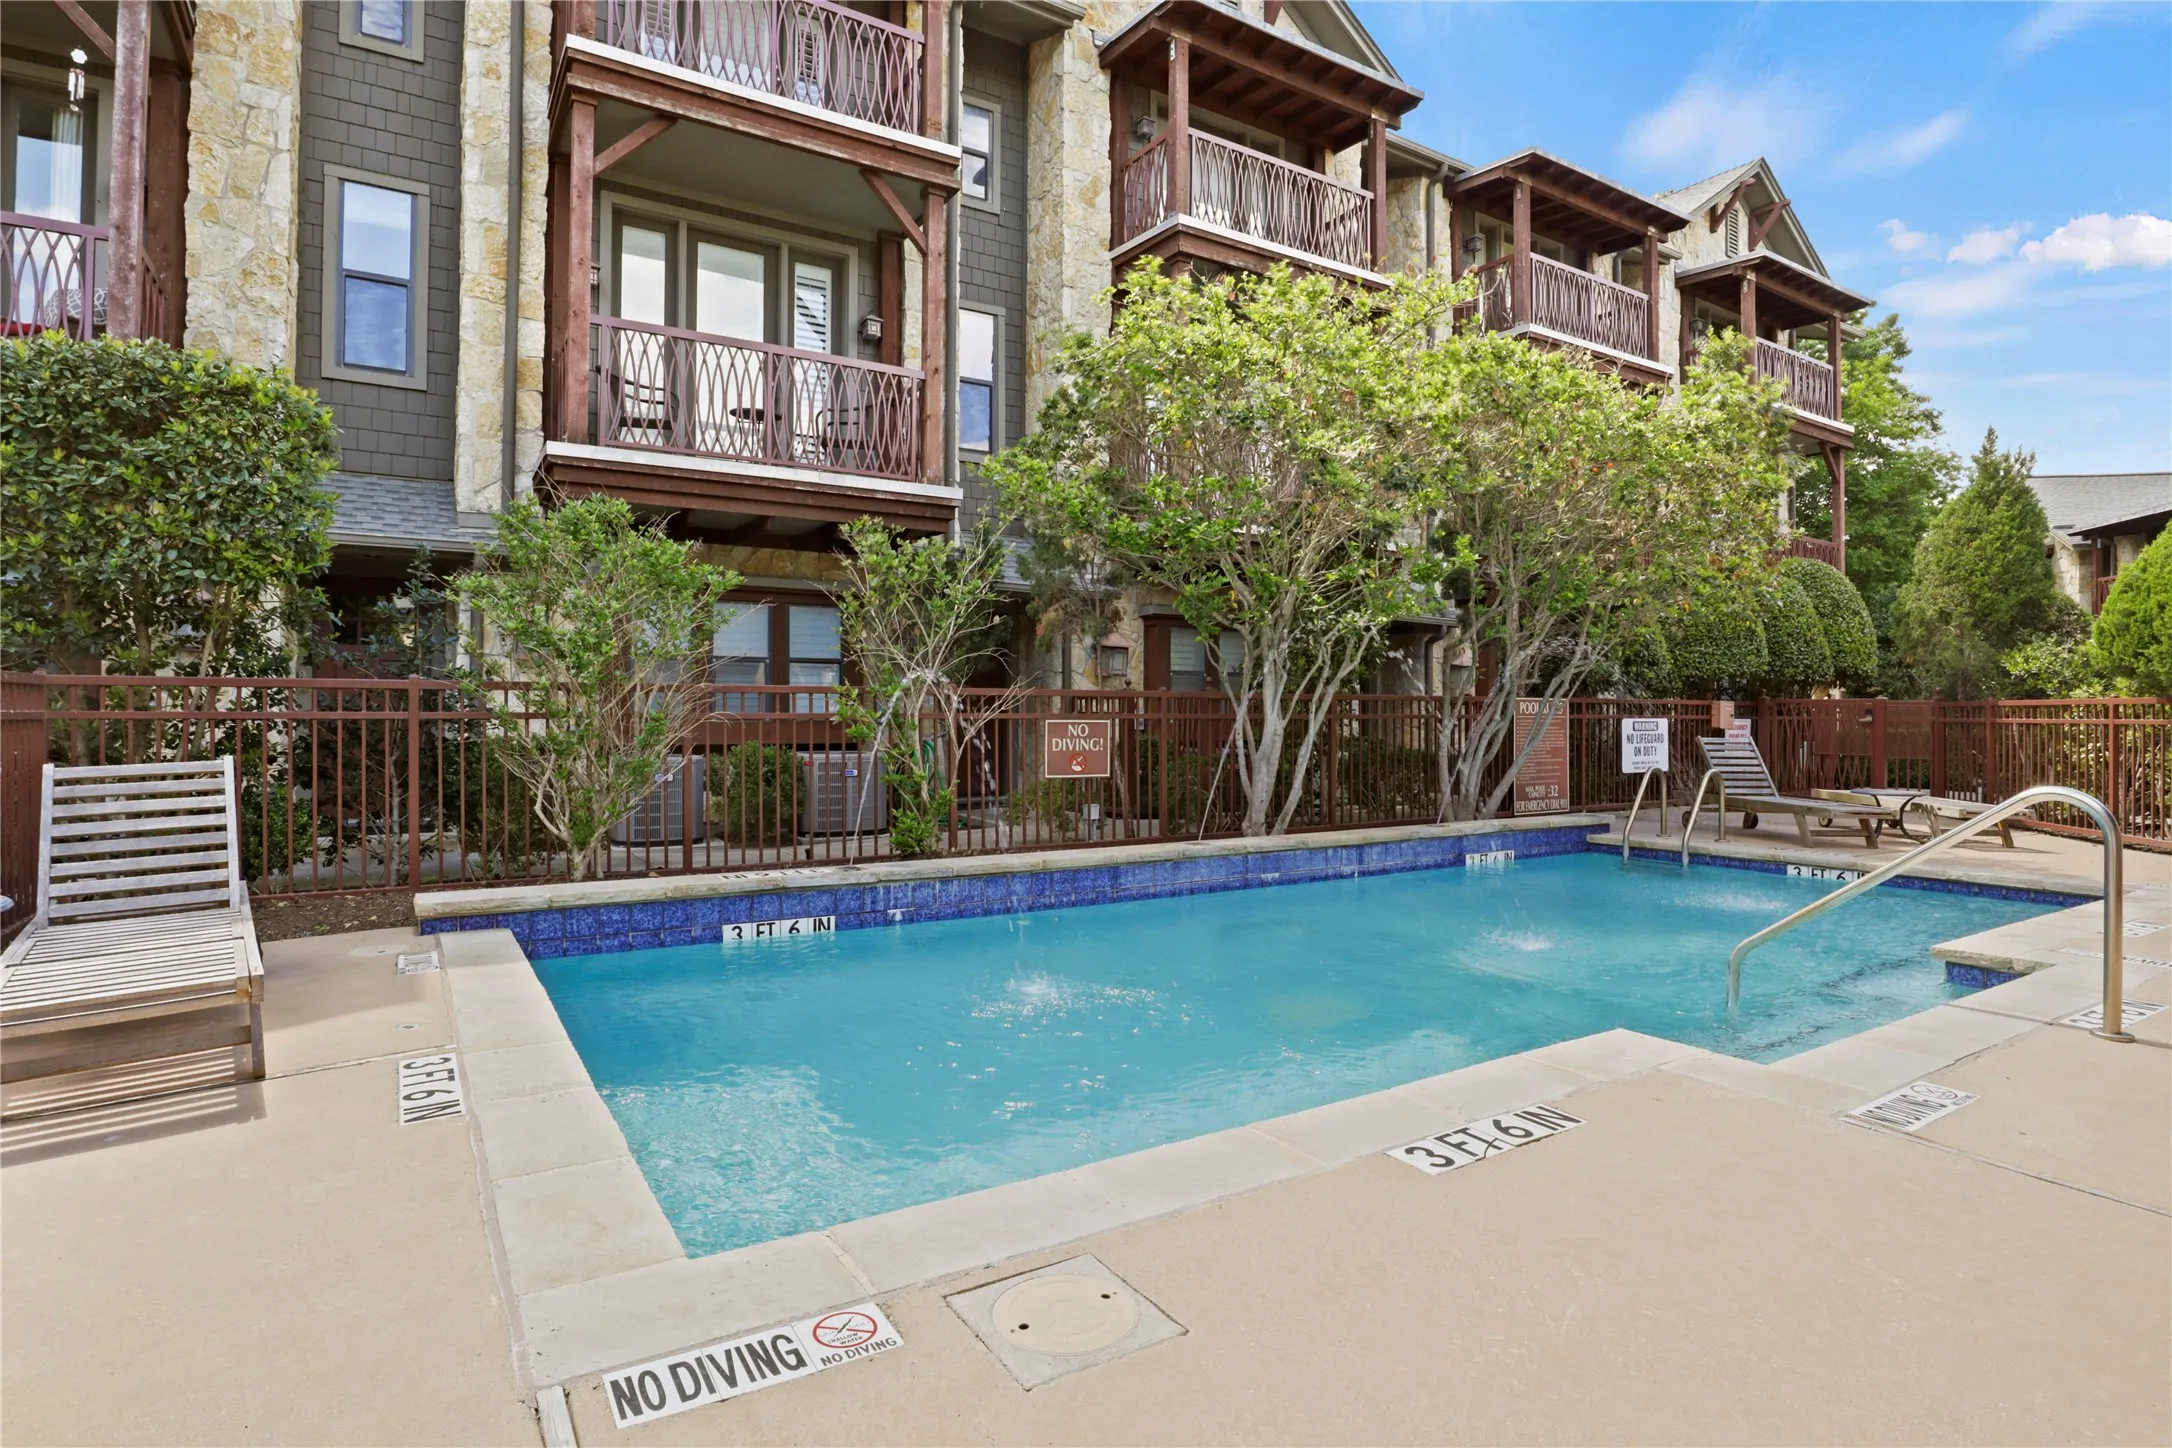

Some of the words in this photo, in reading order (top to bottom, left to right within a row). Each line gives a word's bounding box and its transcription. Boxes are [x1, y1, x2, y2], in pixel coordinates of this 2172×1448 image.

[1519, 701, 1539, 714] POOL
[1068, 724, 1089, 737] NO
[1634, 722, 1658, 731] WARNING
[1052, 737, 1104, 752] DIVING!
[1626, 733, 1634, 744] NO
[1635, 733, 1664, 744] LIFEGUARD
[1633, 746, 1642, 757] ON
[1643, 746, 1657, 757] DUTY
[1516, 801, 1525, 812] FOR
[1525, 799, 1549, 811] EMERGENCY
[1550, 798, 1560, 810] DIAL
[1480, 853, 1489, 863] FT
[1504, 851, 1513, 861] IN
[1793, 866, 1802, 877] 3
[1811, 868, 1826, 879] FT
[1836, 870, 1847, 881] 6
[731, 925, 743, 940] 3
[756, 922, 776, 938] FT
[788, 919, 801, 935] 6
[813, 916, 832, 932] IN
[402, 1056, 453, 1070] 3
[402, 1067, 456, 1088] FT
[402, 1089, 456, 1101] 6
[403, 1099, 463, 1124] IN
[1512, 1105, 1583, 1132] IN
[1492, 1118, 1535, 1139] 6
[1432, 1127, 1504, 1158] FT
[1404, 1146, 1456, 1168] 3
[840, 1336, 864, 1345] WATER
[820, 1353, 844, 1367] NO
[844, 1337, 897, 1359] DIVING
[609, 1370, 668, 1421] NO
[667, 1333, 809, 1404] DIVING
